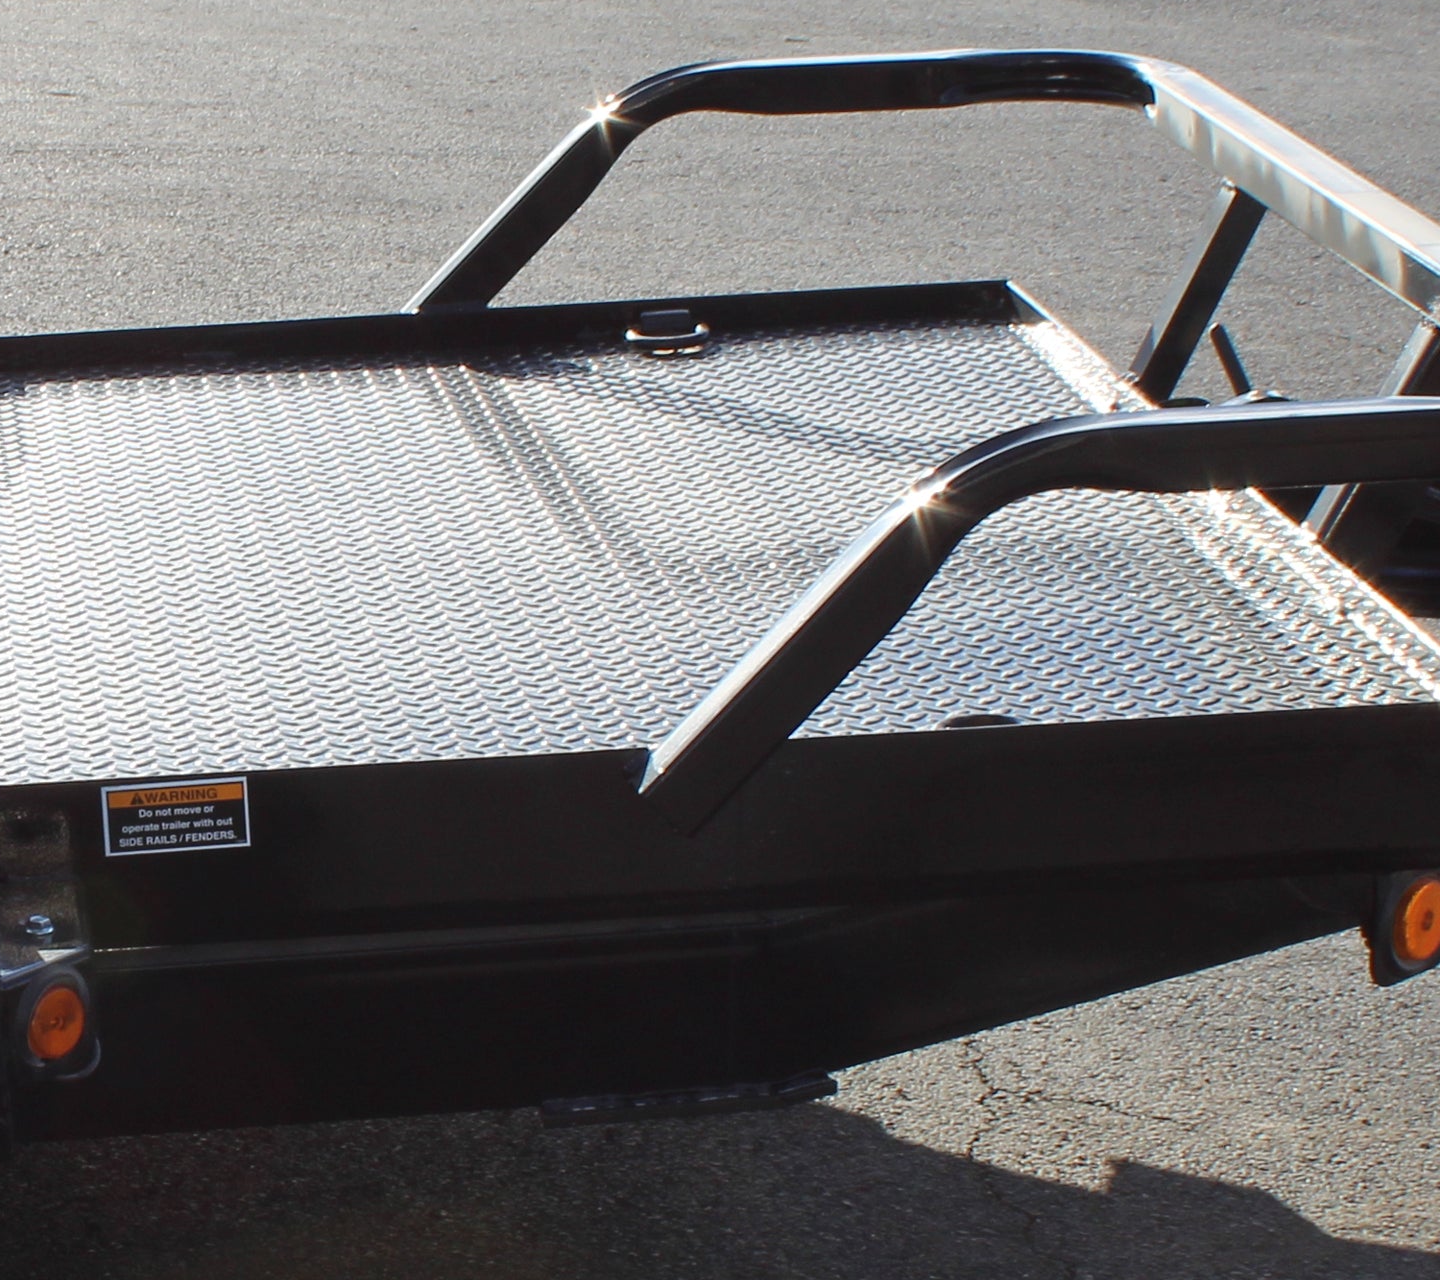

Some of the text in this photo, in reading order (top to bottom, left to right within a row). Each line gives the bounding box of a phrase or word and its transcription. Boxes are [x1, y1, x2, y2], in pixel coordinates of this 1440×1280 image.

[144, 787, 218, 804] WARNING
[138, 805, 215, 818] Do not move or
[122, 816, 233, 835] operate trailer with out
[119, 836, 144, 848] SIDE
[146, 834, 177, 846] RAILS
